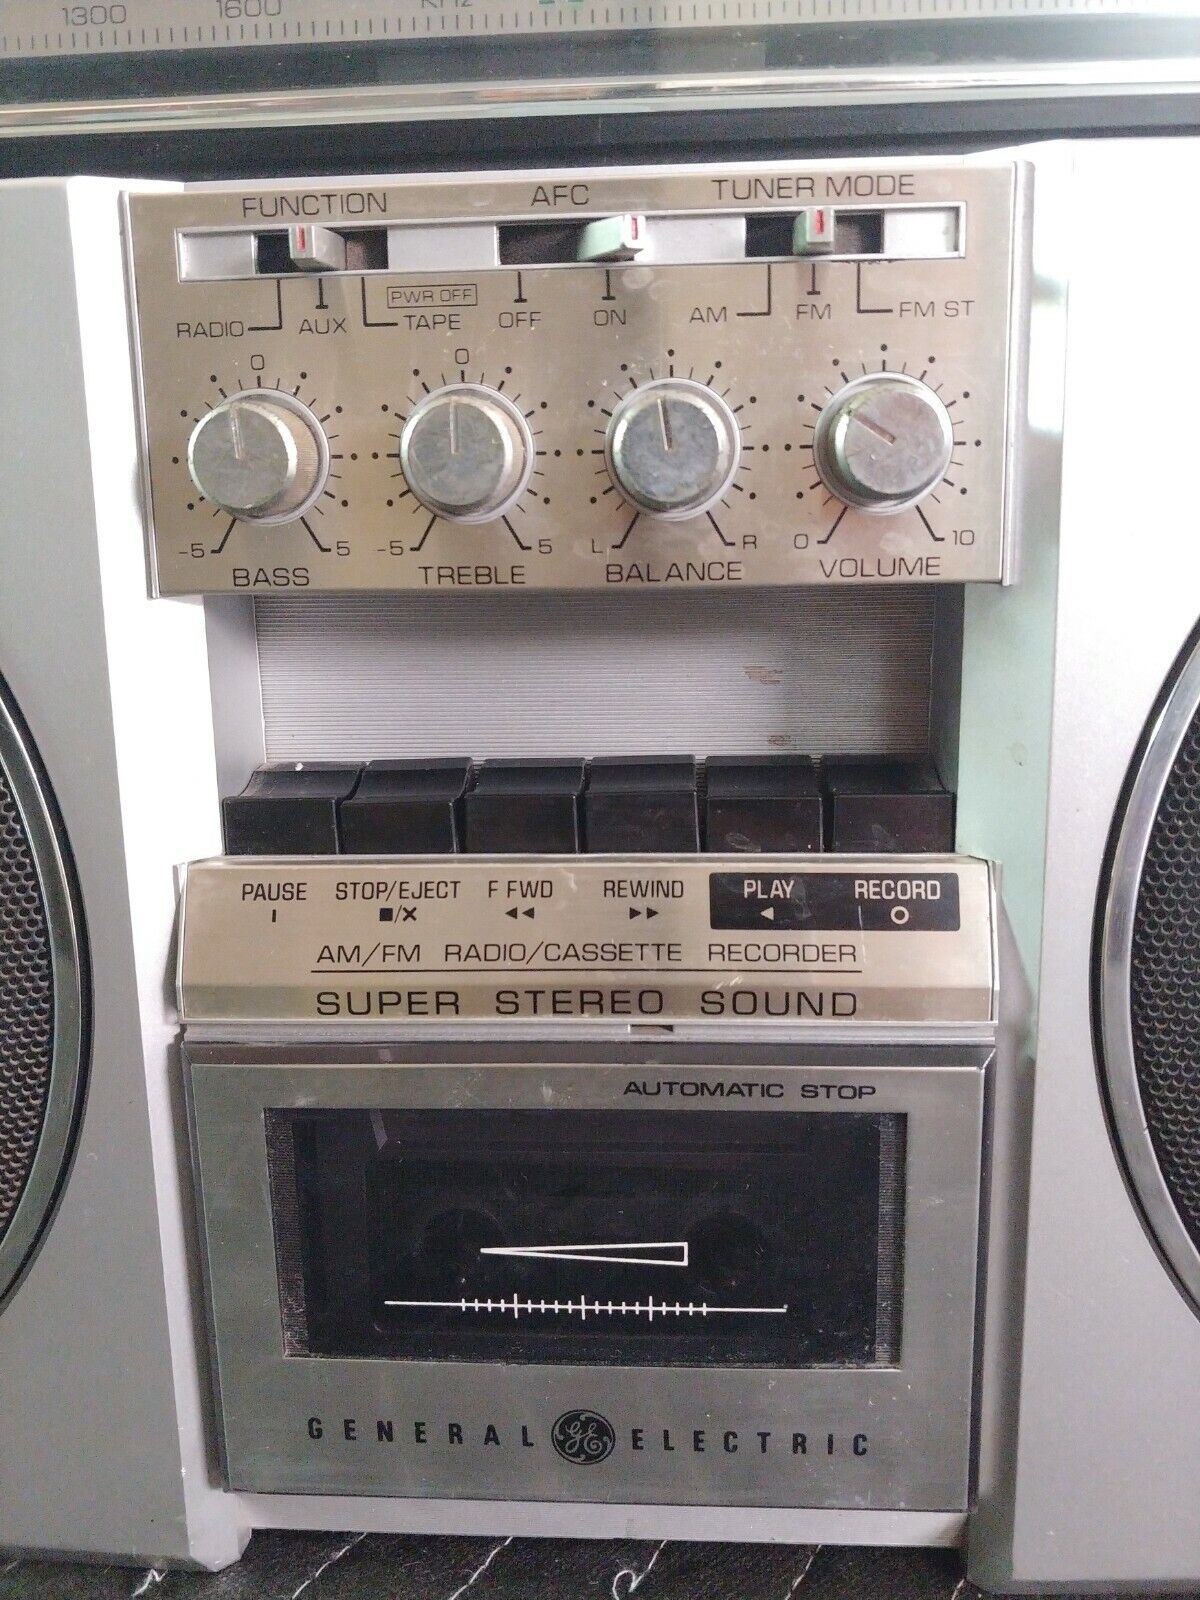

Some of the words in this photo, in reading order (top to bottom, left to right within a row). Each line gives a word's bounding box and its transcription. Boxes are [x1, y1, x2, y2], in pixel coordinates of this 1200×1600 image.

[61, 4, 127, 27] 1300
[215, 0, 282, 19] 1600
[531, 184, 591, 207] AFC
[712, 178, 815, 202] TUNER
[826, 174, 916, 198] MODE
[242, 192, 388, 219] FUNCTION
[390, 289, 436, 304] PWR
[439, 287, 474, 302] OFF
[592, 308, 627, 327] ON
[689, 306, 728, 324] AM
[795, 303, 832, 320] FM
[898, 301, 936, 319] FM
[943, 300, 975, 318] ST
[298, 317, 348, 336] AUX
[402, 313, 462, 331] TAPE
[498, 311, 542, 329] OFF
[176, 321, 245, 339] RADIO
[336, 539, 351, 556] 5
[538, 538, 553, 554] 5
[591, 538, 603, 554] L
[742, 535, 757, 551] R
[793, 533, 809, 550] 0
[951, 530, 976, 546] 10
[178, 543, 206, 559] -5
[376, 540, 404, 557] -5
[418, 565, 526, 585] TREBLE
[606, 561, 743, 583] BALANCE
[819, 556, 941, 577] VOLUME
[232, 567, 310, 586] BASS
[241, 882, 308, 902] PAUSE
[335, 880, 462, 902] STOP/EJECT
[488, 881, 499, 899] F
[506, 880, 553, 899] FWD
[603, 880, 684, 899] REWIND
[743, 879, 795, 899] PLAY
[854, 879, 941, 900] RECORD
[316, 942, 421, 967] AM/FM
[444, 940, 682, 965] RADIO/CASSETTE
[708, 944, 857, 963] RECORDER
[316, 990, 460, 1016] SUPER
[495, 990, 664, 1016] STEREO
[701, 991, 858, 1017] SOUND
[623, 1081, 784, 1099] AUTOMATIC
[801, 1083, 877, 1100] STOP
[307, 1417, 534, 1447] GENERAL
[631, 1428, 869, 1456] ELECTRIC
